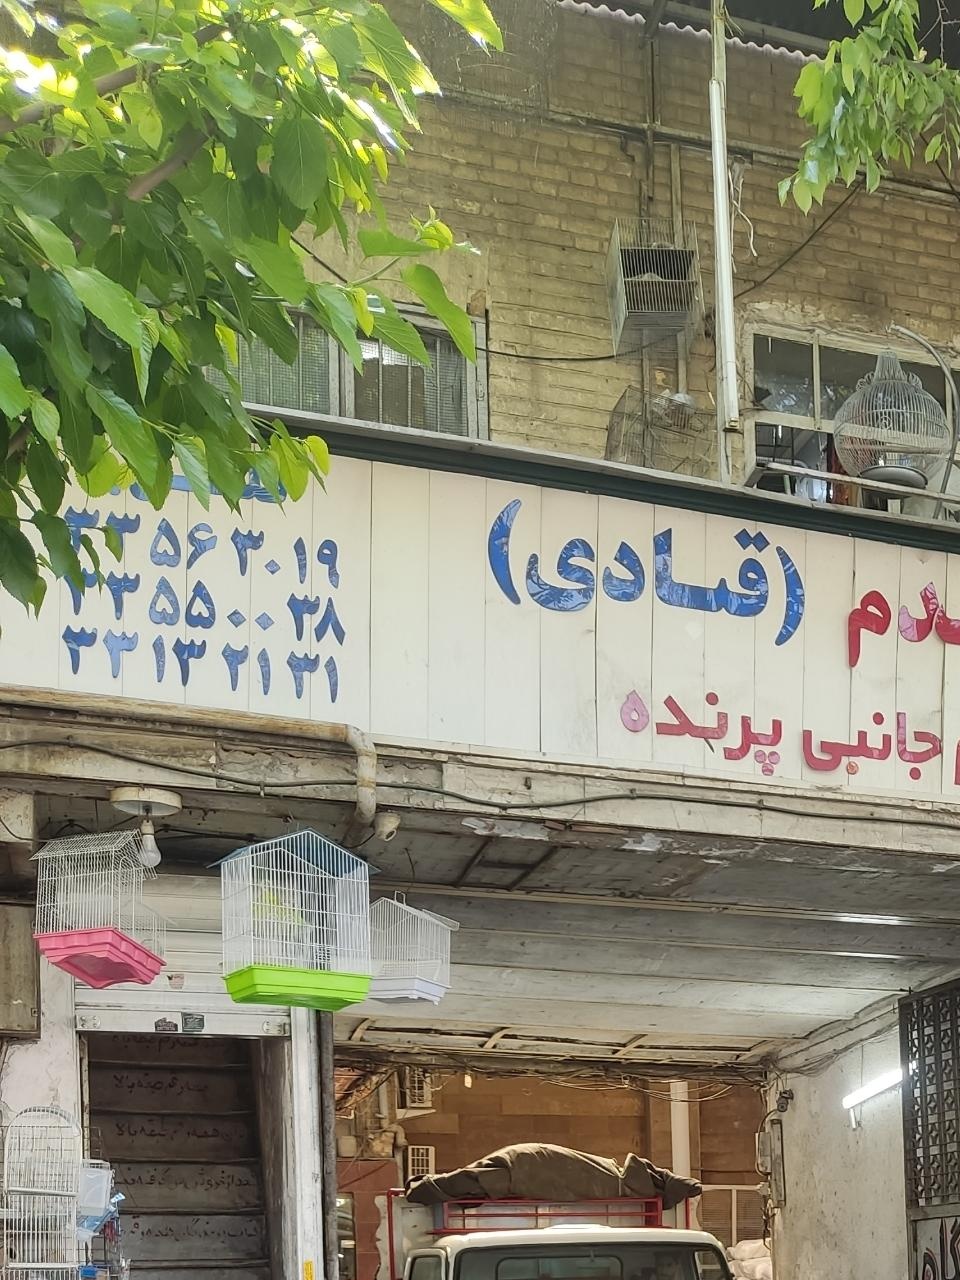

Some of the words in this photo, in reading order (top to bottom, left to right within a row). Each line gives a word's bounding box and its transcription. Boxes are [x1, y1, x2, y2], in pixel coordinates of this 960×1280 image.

[61, 624, 339, 703] ۳۳۱۳۲۱۳۱
[619, 689, 783, 776] پرنده
[802, 711, 942, 780] جانبی
